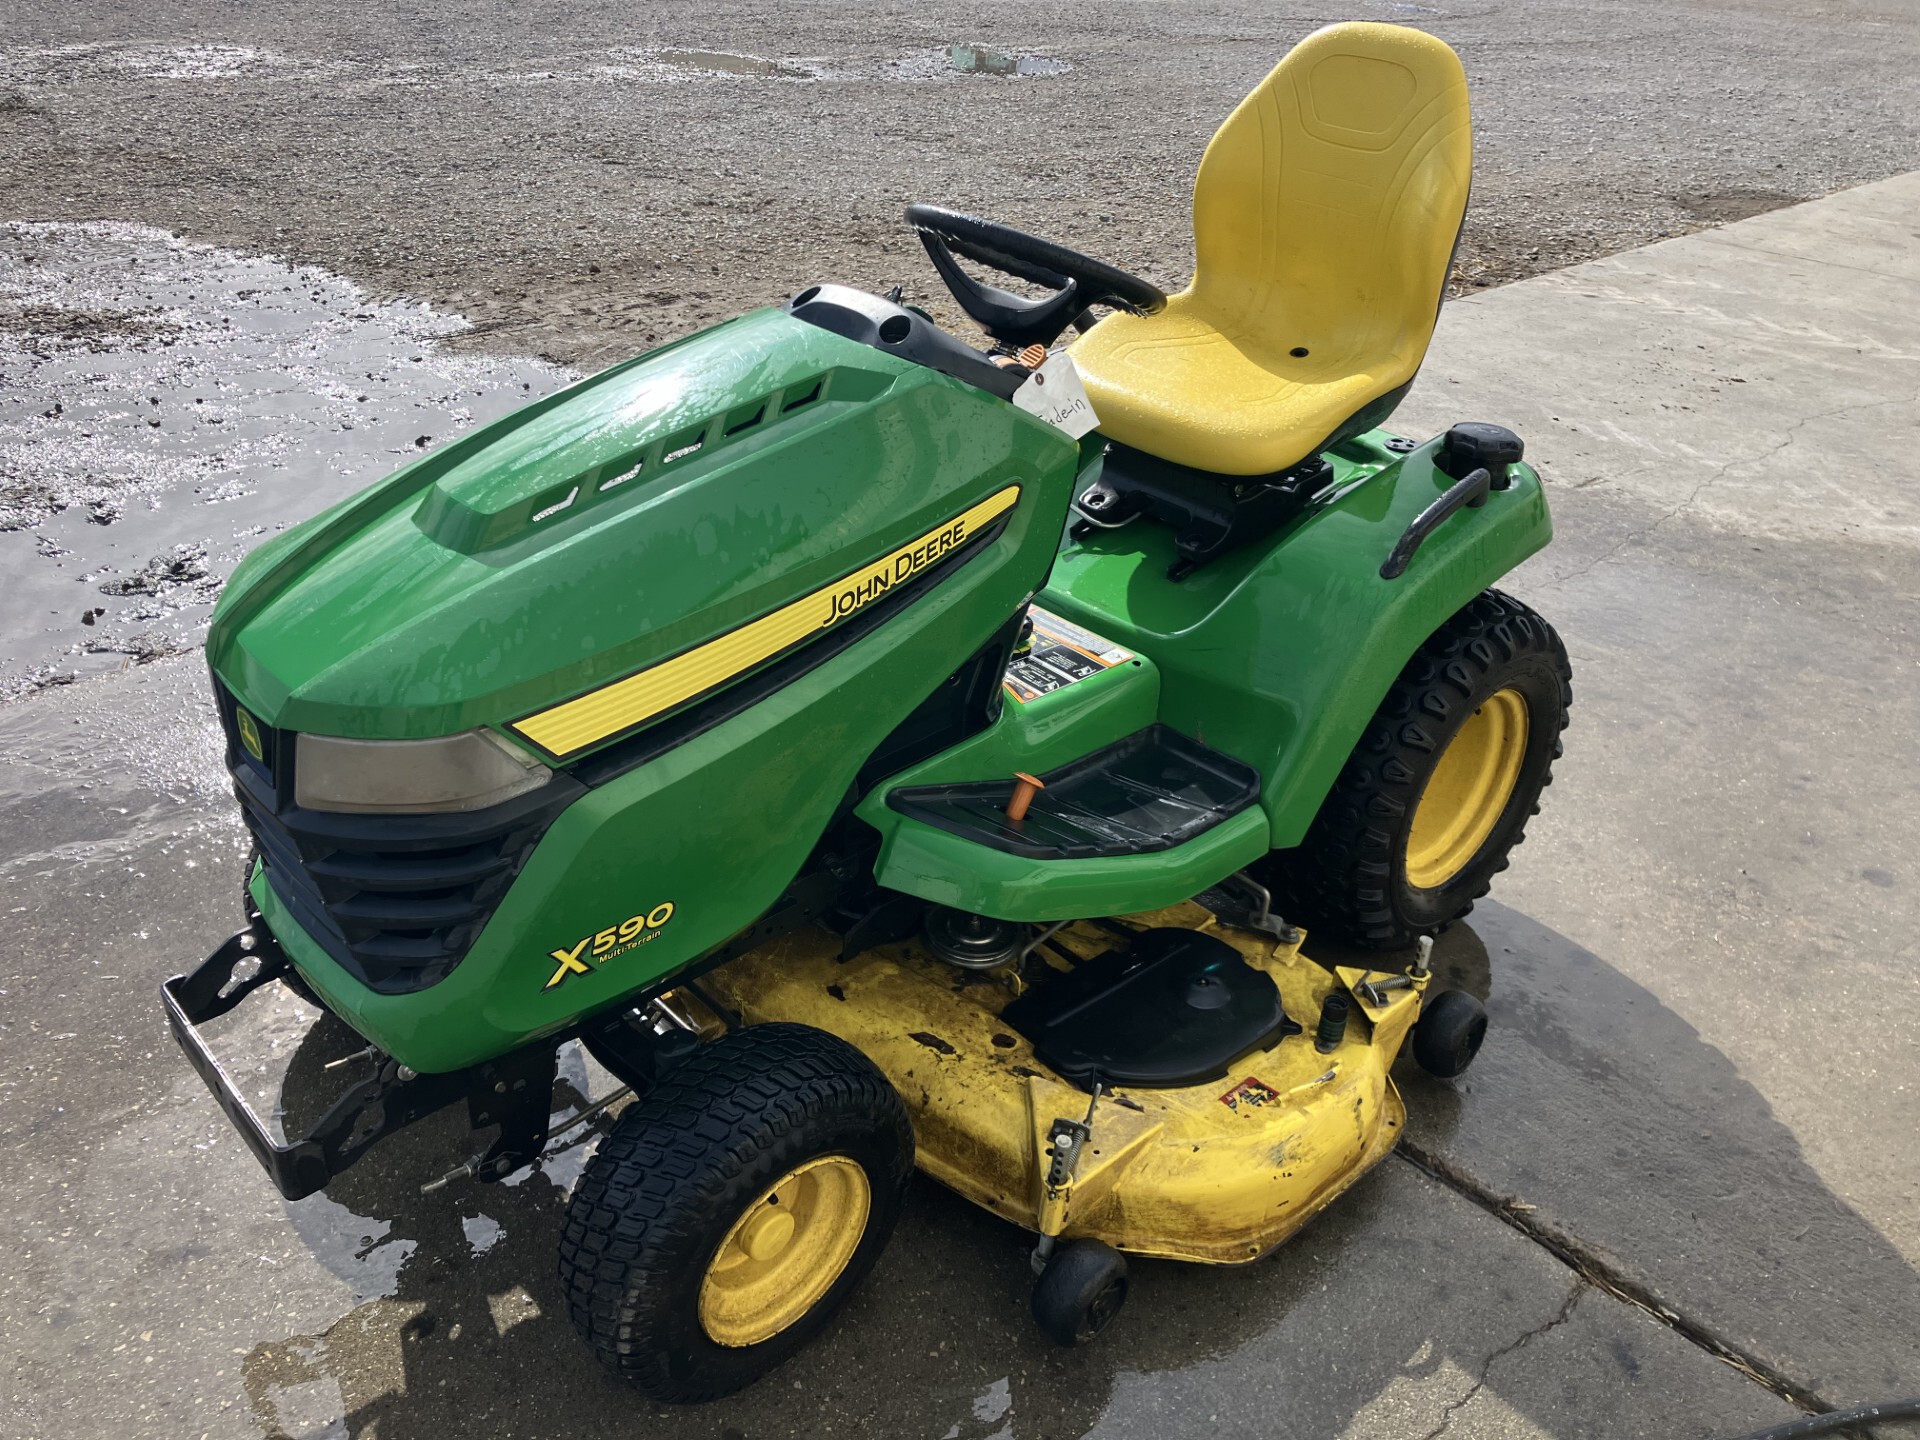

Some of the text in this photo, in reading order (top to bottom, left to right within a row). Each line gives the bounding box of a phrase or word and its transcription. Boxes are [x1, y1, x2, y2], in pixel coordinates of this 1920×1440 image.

[823, 520, 966, 626] JOHN DEERE
[543, 901, 675, 990] X590
[599, 930, 662, 964] Multi-Terrain
